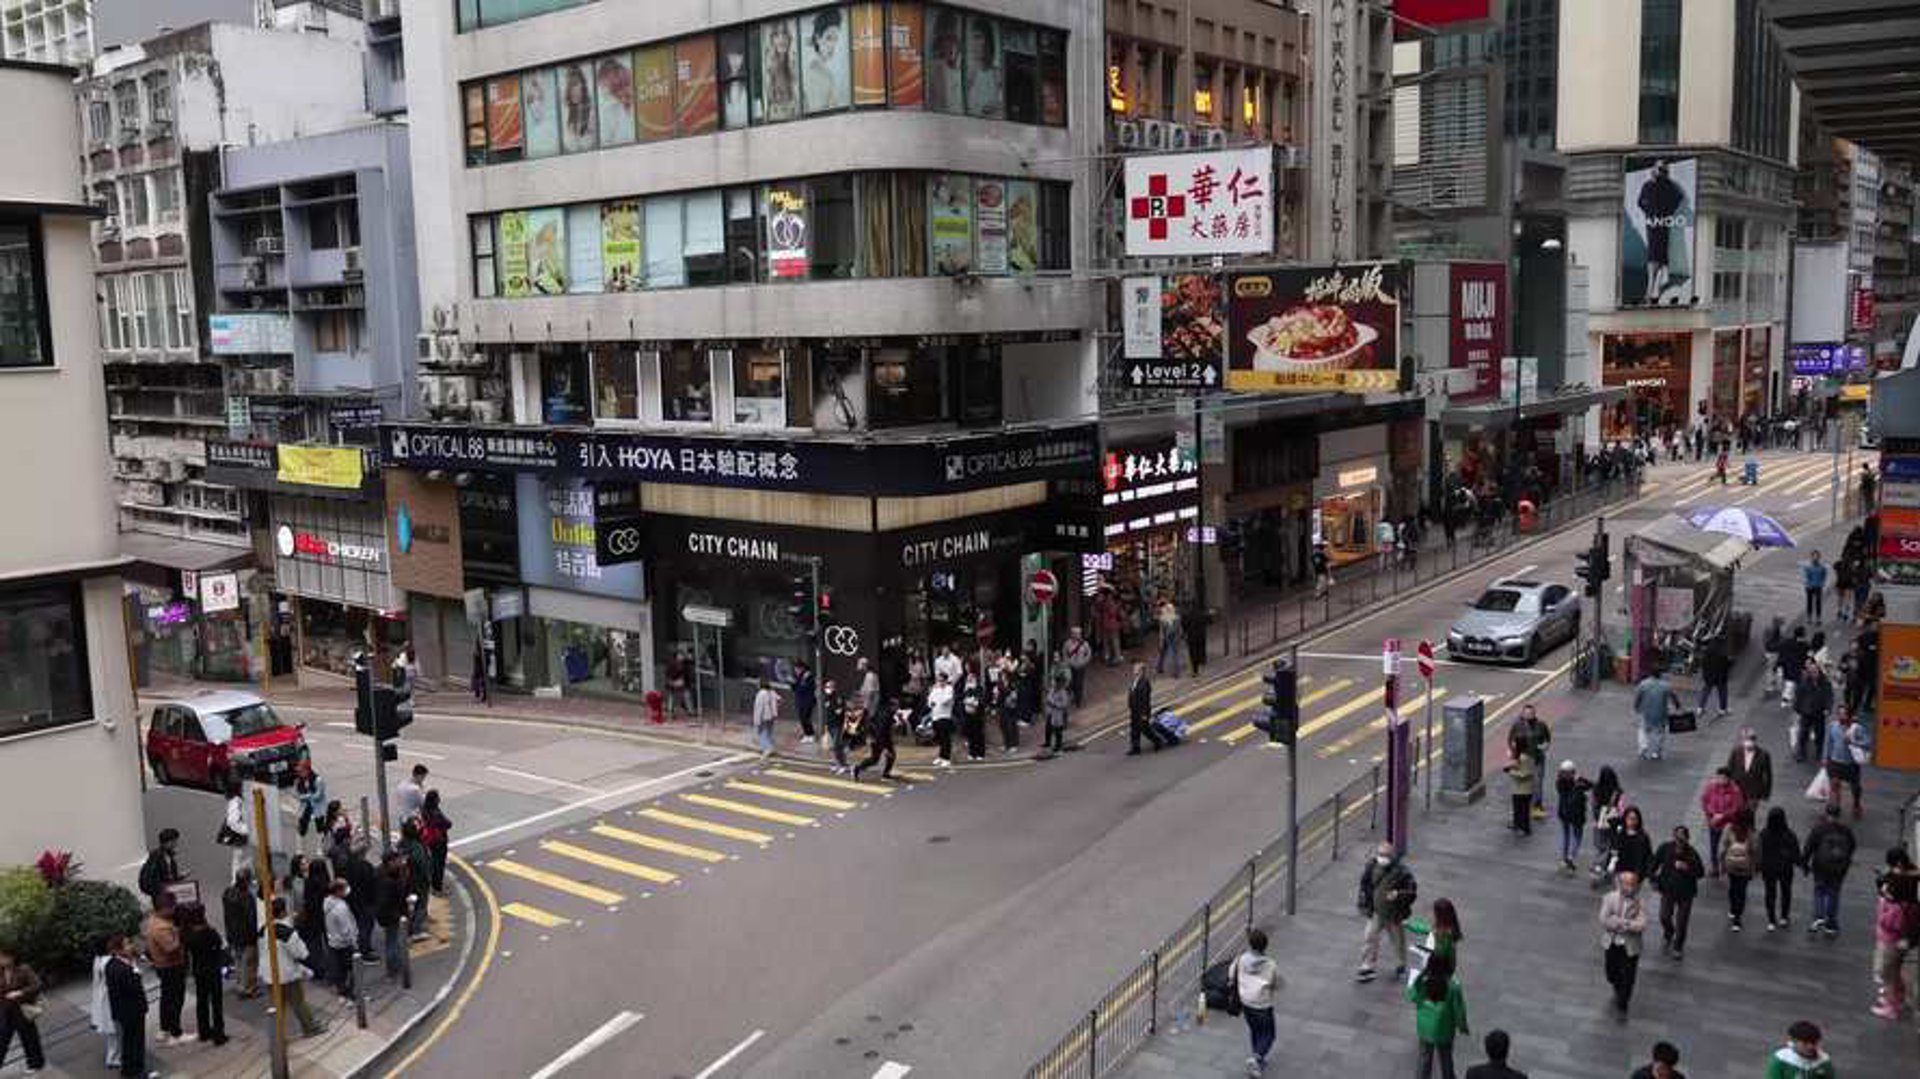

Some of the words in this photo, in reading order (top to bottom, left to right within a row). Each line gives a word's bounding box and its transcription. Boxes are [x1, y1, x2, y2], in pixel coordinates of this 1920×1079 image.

[1332, 22, 1344, 132] TRAVEL
[1188, 165, 1264, 210] 華仁
[1191, 211, 1251, 239] 大藥房
[1462, 281, 1495, 318] MUJI
[1146, 363, 1187, 378] Level
[1192, 363, 1201, 378] 2
[411, 434, 467, 459] OPTICAL
[468, 436, 485, 460] 88
[579, 442, 612, 467] 引入
[618, 447, 675, 470] HOYA
[680, 448, 799, 480] 日本驗配概念
[966, 450, 1018, 474] OPTICAL
[688, 532, 723, 553] CITY
[727, 536, 779, 561] CHAIN
[902, 538, 939, 566] CITY
[942, 530, 990, 558] CHAIN
